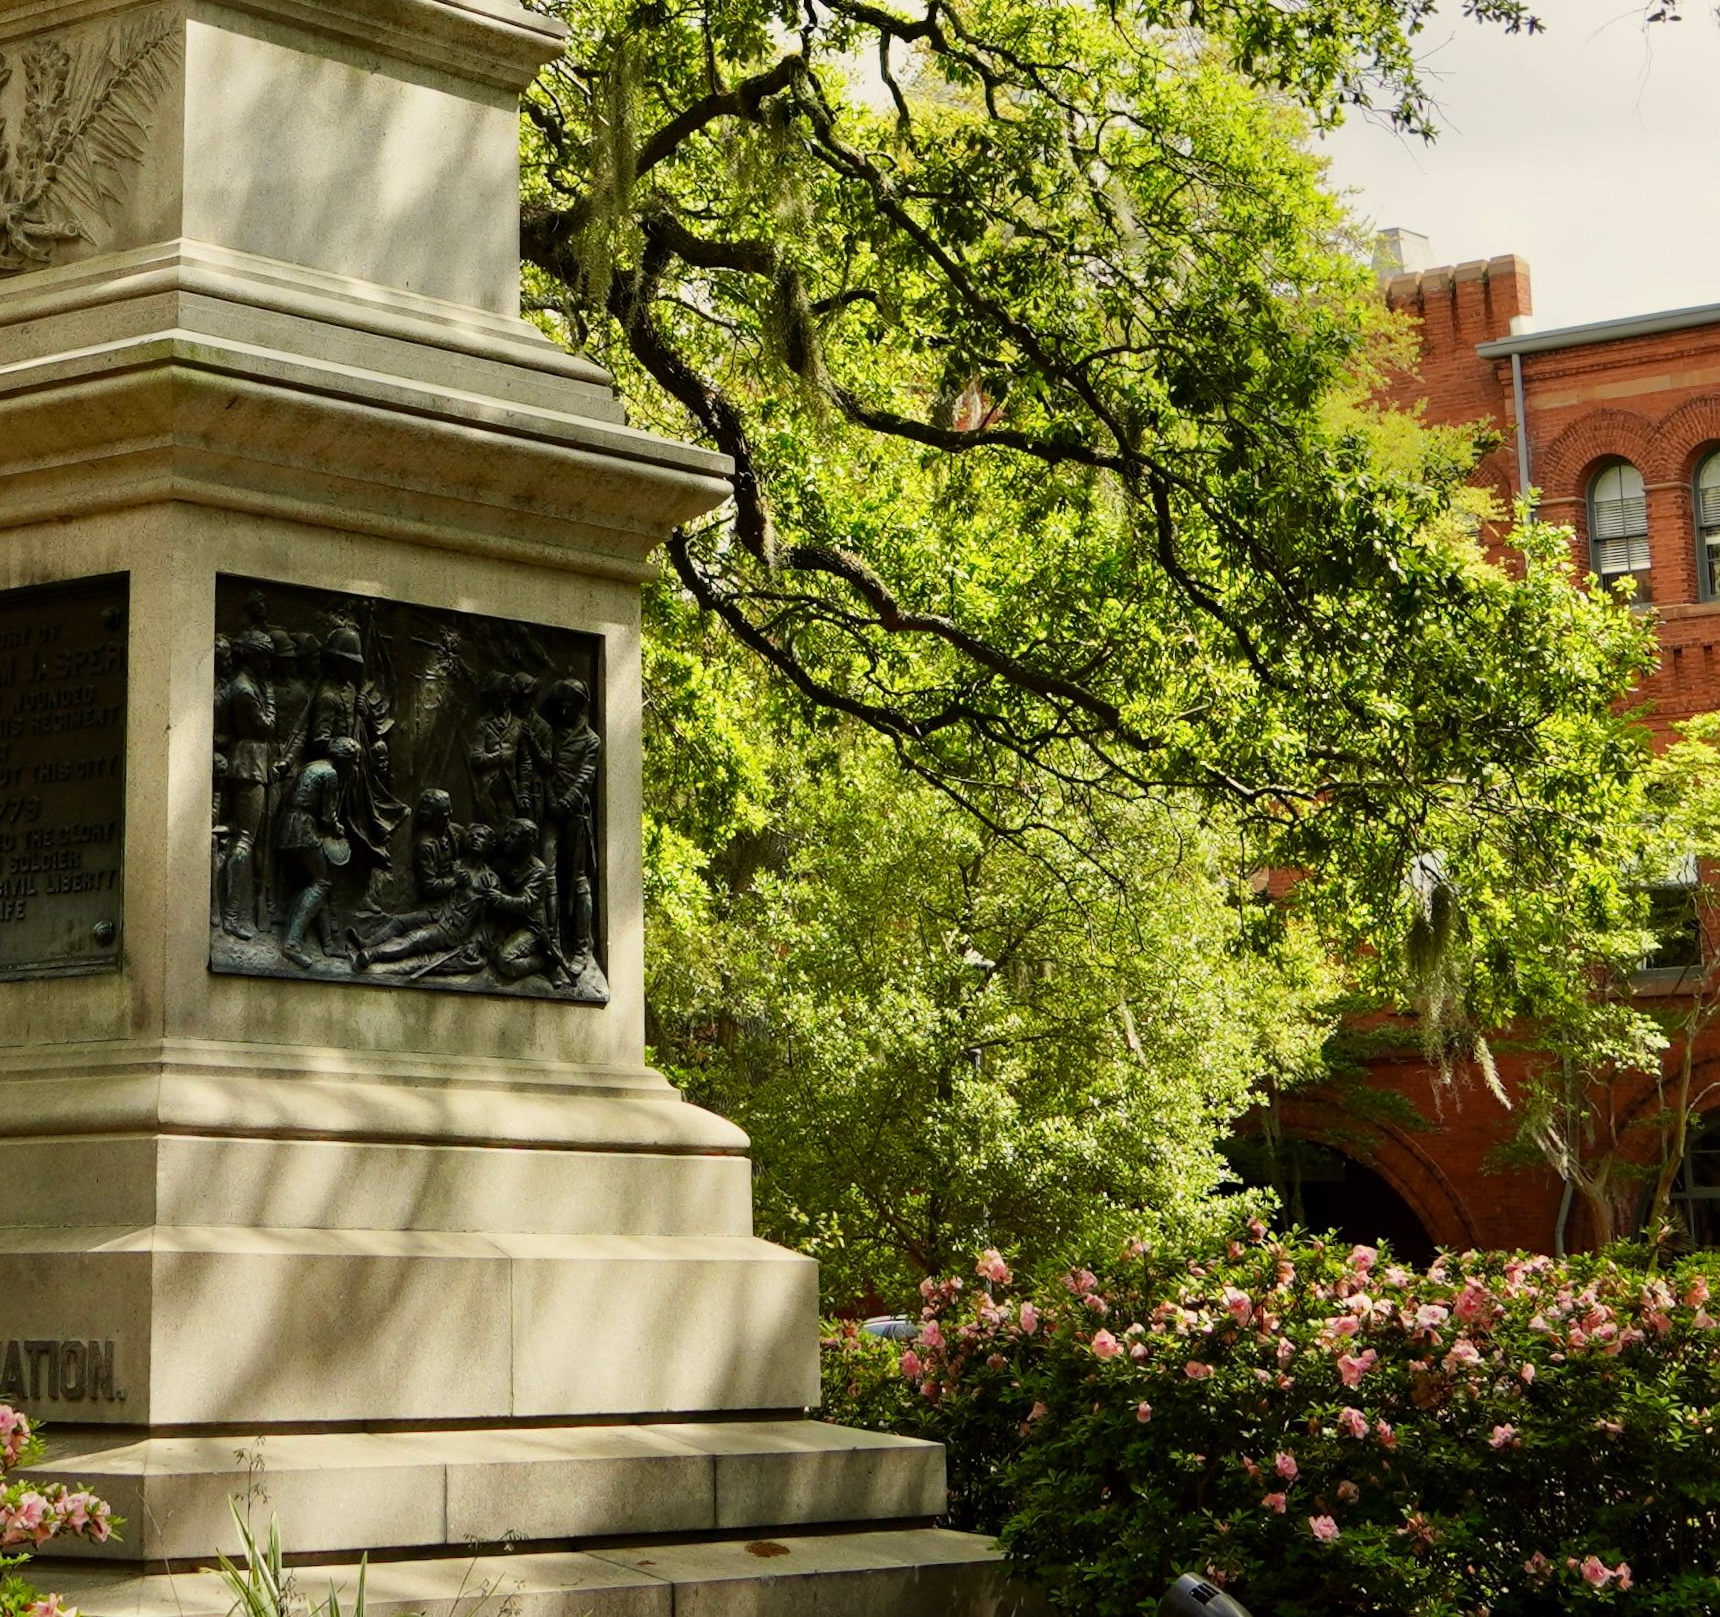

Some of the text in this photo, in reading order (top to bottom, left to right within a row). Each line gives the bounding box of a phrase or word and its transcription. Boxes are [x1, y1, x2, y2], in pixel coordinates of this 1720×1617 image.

[38, 622, 61, 644] OF
[24, 642, 124, 684] JASPER
[11, 686, 95, 715] WOUNDED
[31, 704, 121, 733] REGIMENT
[30, 759, 72, 784] THIS
[77, 755, 119, 780] CITY
[23, 825, 54, 848] THE
[59, 820, 117, 845] GLORY
[9, 848, 81, 876] SOLDIER
[46, 868, 117, 896] LIBERTY
